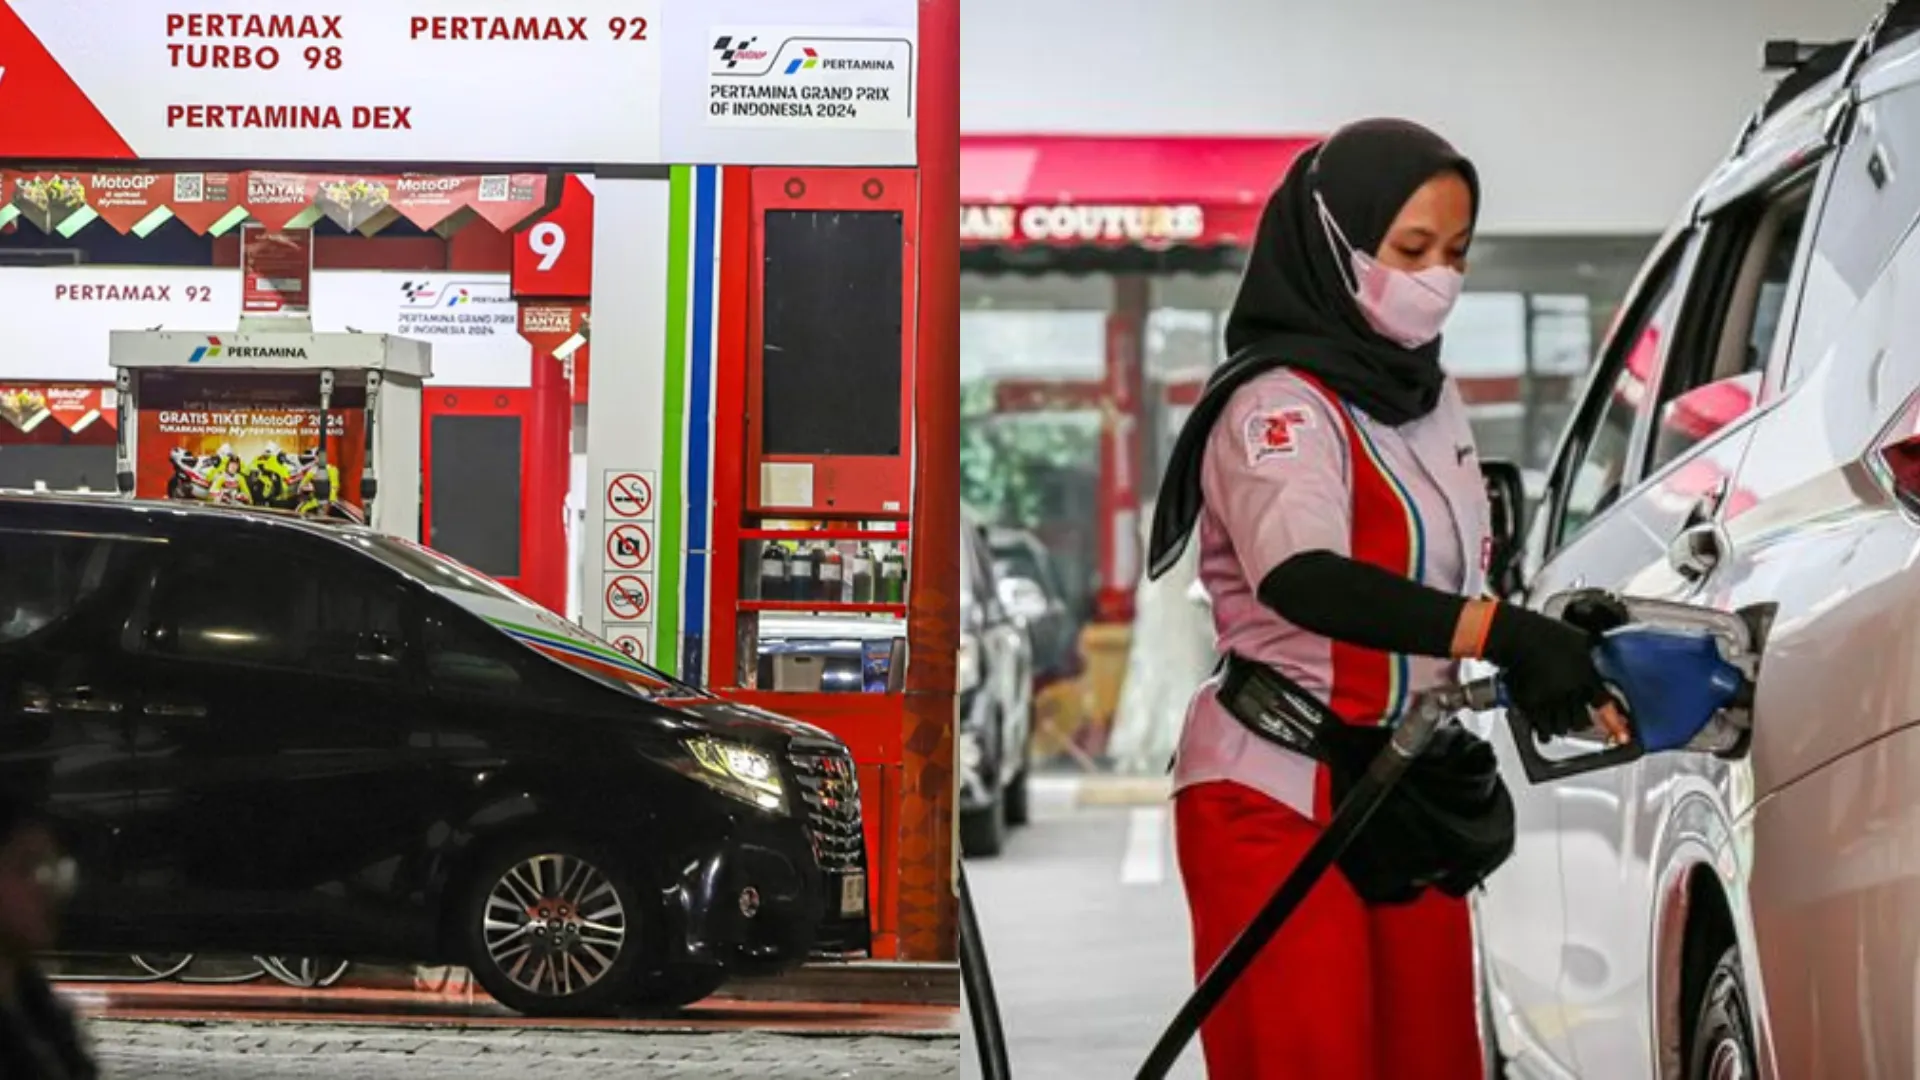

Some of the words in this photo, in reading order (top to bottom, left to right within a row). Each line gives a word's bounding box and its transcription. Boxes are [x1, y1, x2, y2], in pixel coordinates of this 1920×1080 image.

[166, 14, 342, 38] PERTAMAX
[410, 16, 588, 41] PERTAMAX
[608, 16, 648, 41] 92
[167, 44, 280, 70] TURBO
[303, 46, 343, 70] 98
[822, 59, 895, 70] PERTAMINA
[711, 85, 798, 99] PERTAMINA
[801, 86, 853, 100] GRAND
[856, 87, 890, 101] PRIX
[166, 105, 342, 129] PERTAMINA
[352, 106, 412, 130] DEX
[710, 102, 729, 115] OF
[732, 102, 813, 116] INDONESIA
[816, 103, 857, 117] 2024
[91, 175, 154, 189] MotoGP
[397, 178, 460, 191] MotoGP
[1020, 205, 1204, 240] COUTURE
[528, 221, 566, 271] 9
[55, 284, 171, 301] PERTAMAX
[185, 285, 212, 302] 92
[399, 312, 455, 323] PERTAMINA
[227, 346, 307, 359] PERTAMINA
[159, 410, 208, 424] GRATIS
[211, 412, 248, 425] TIKET
[251, 413, 303, 426] MotoGP
